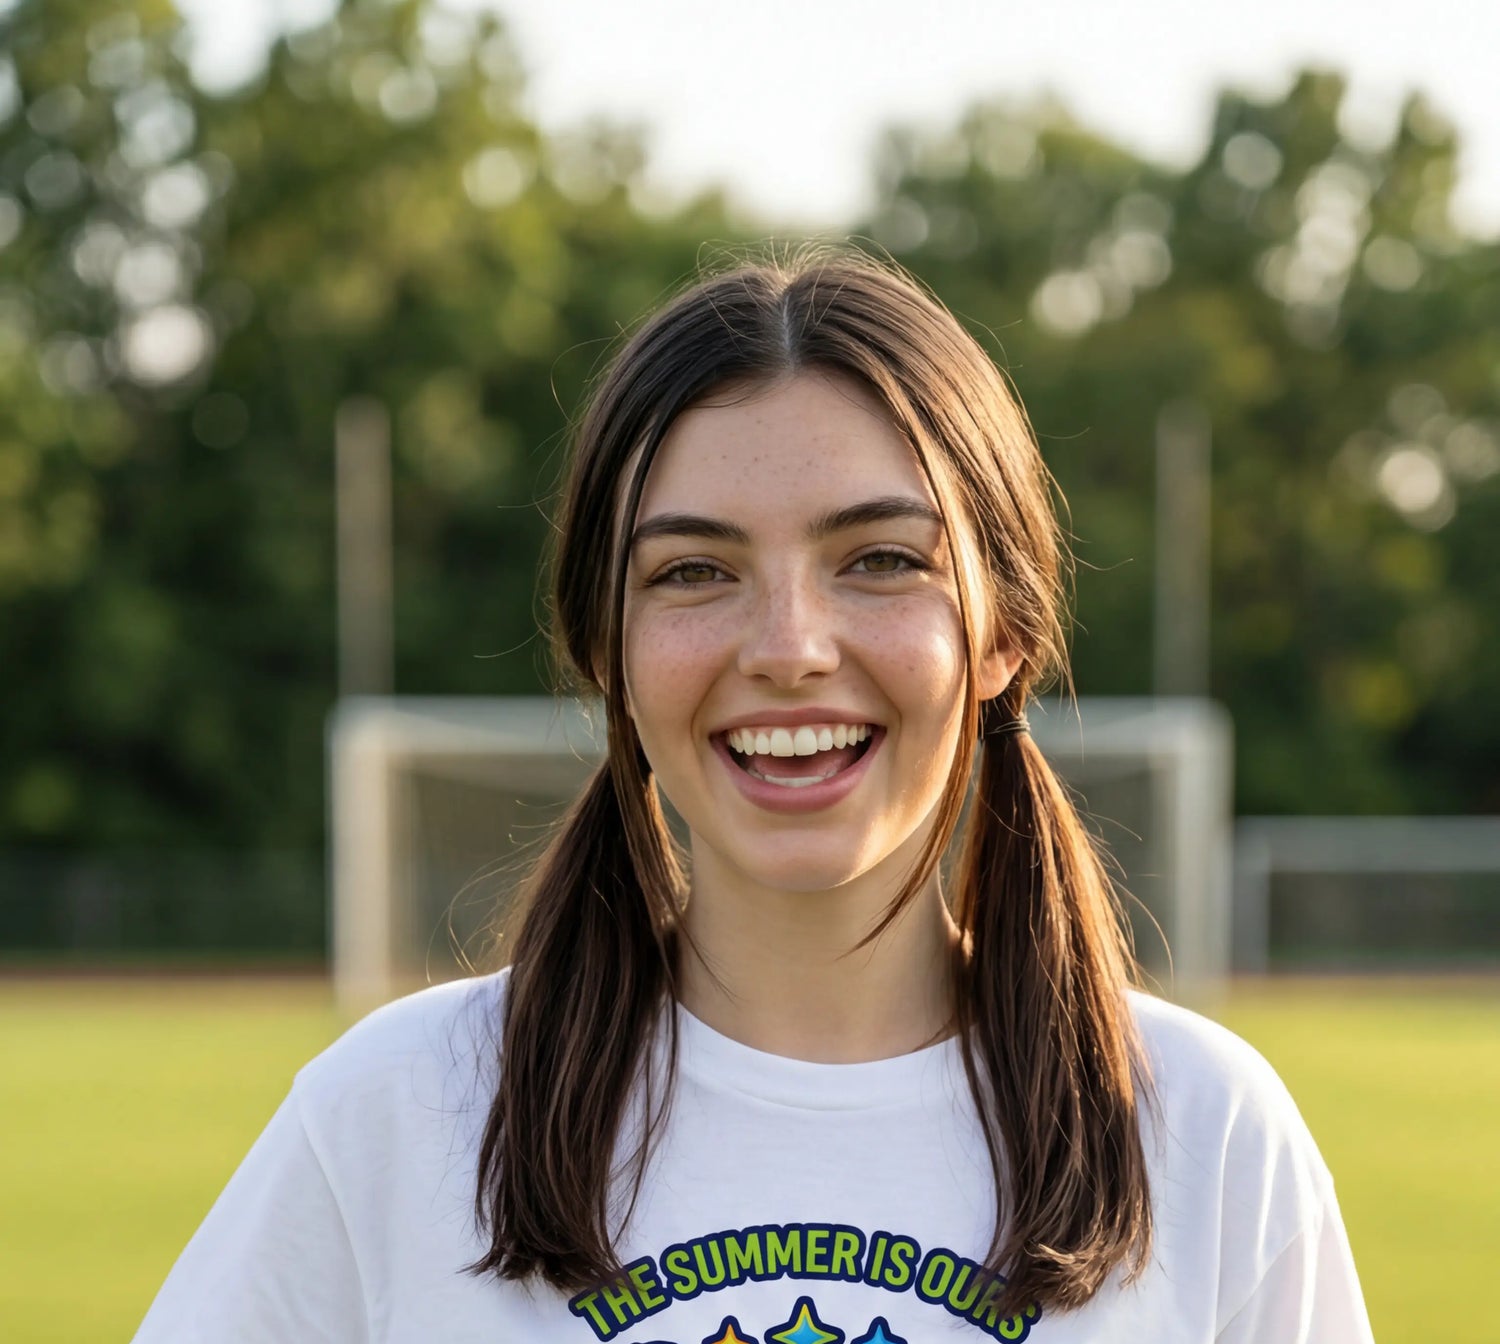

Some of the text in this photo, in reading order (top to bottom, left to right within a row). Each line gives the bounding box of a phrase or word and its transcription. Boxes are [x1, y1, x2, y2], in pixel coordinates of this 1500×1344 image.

[573, 1261, 667, 1337] THE
[664, 1228, 863, 1294] SUMMER
[868, 1235, 917, 1288] IS
